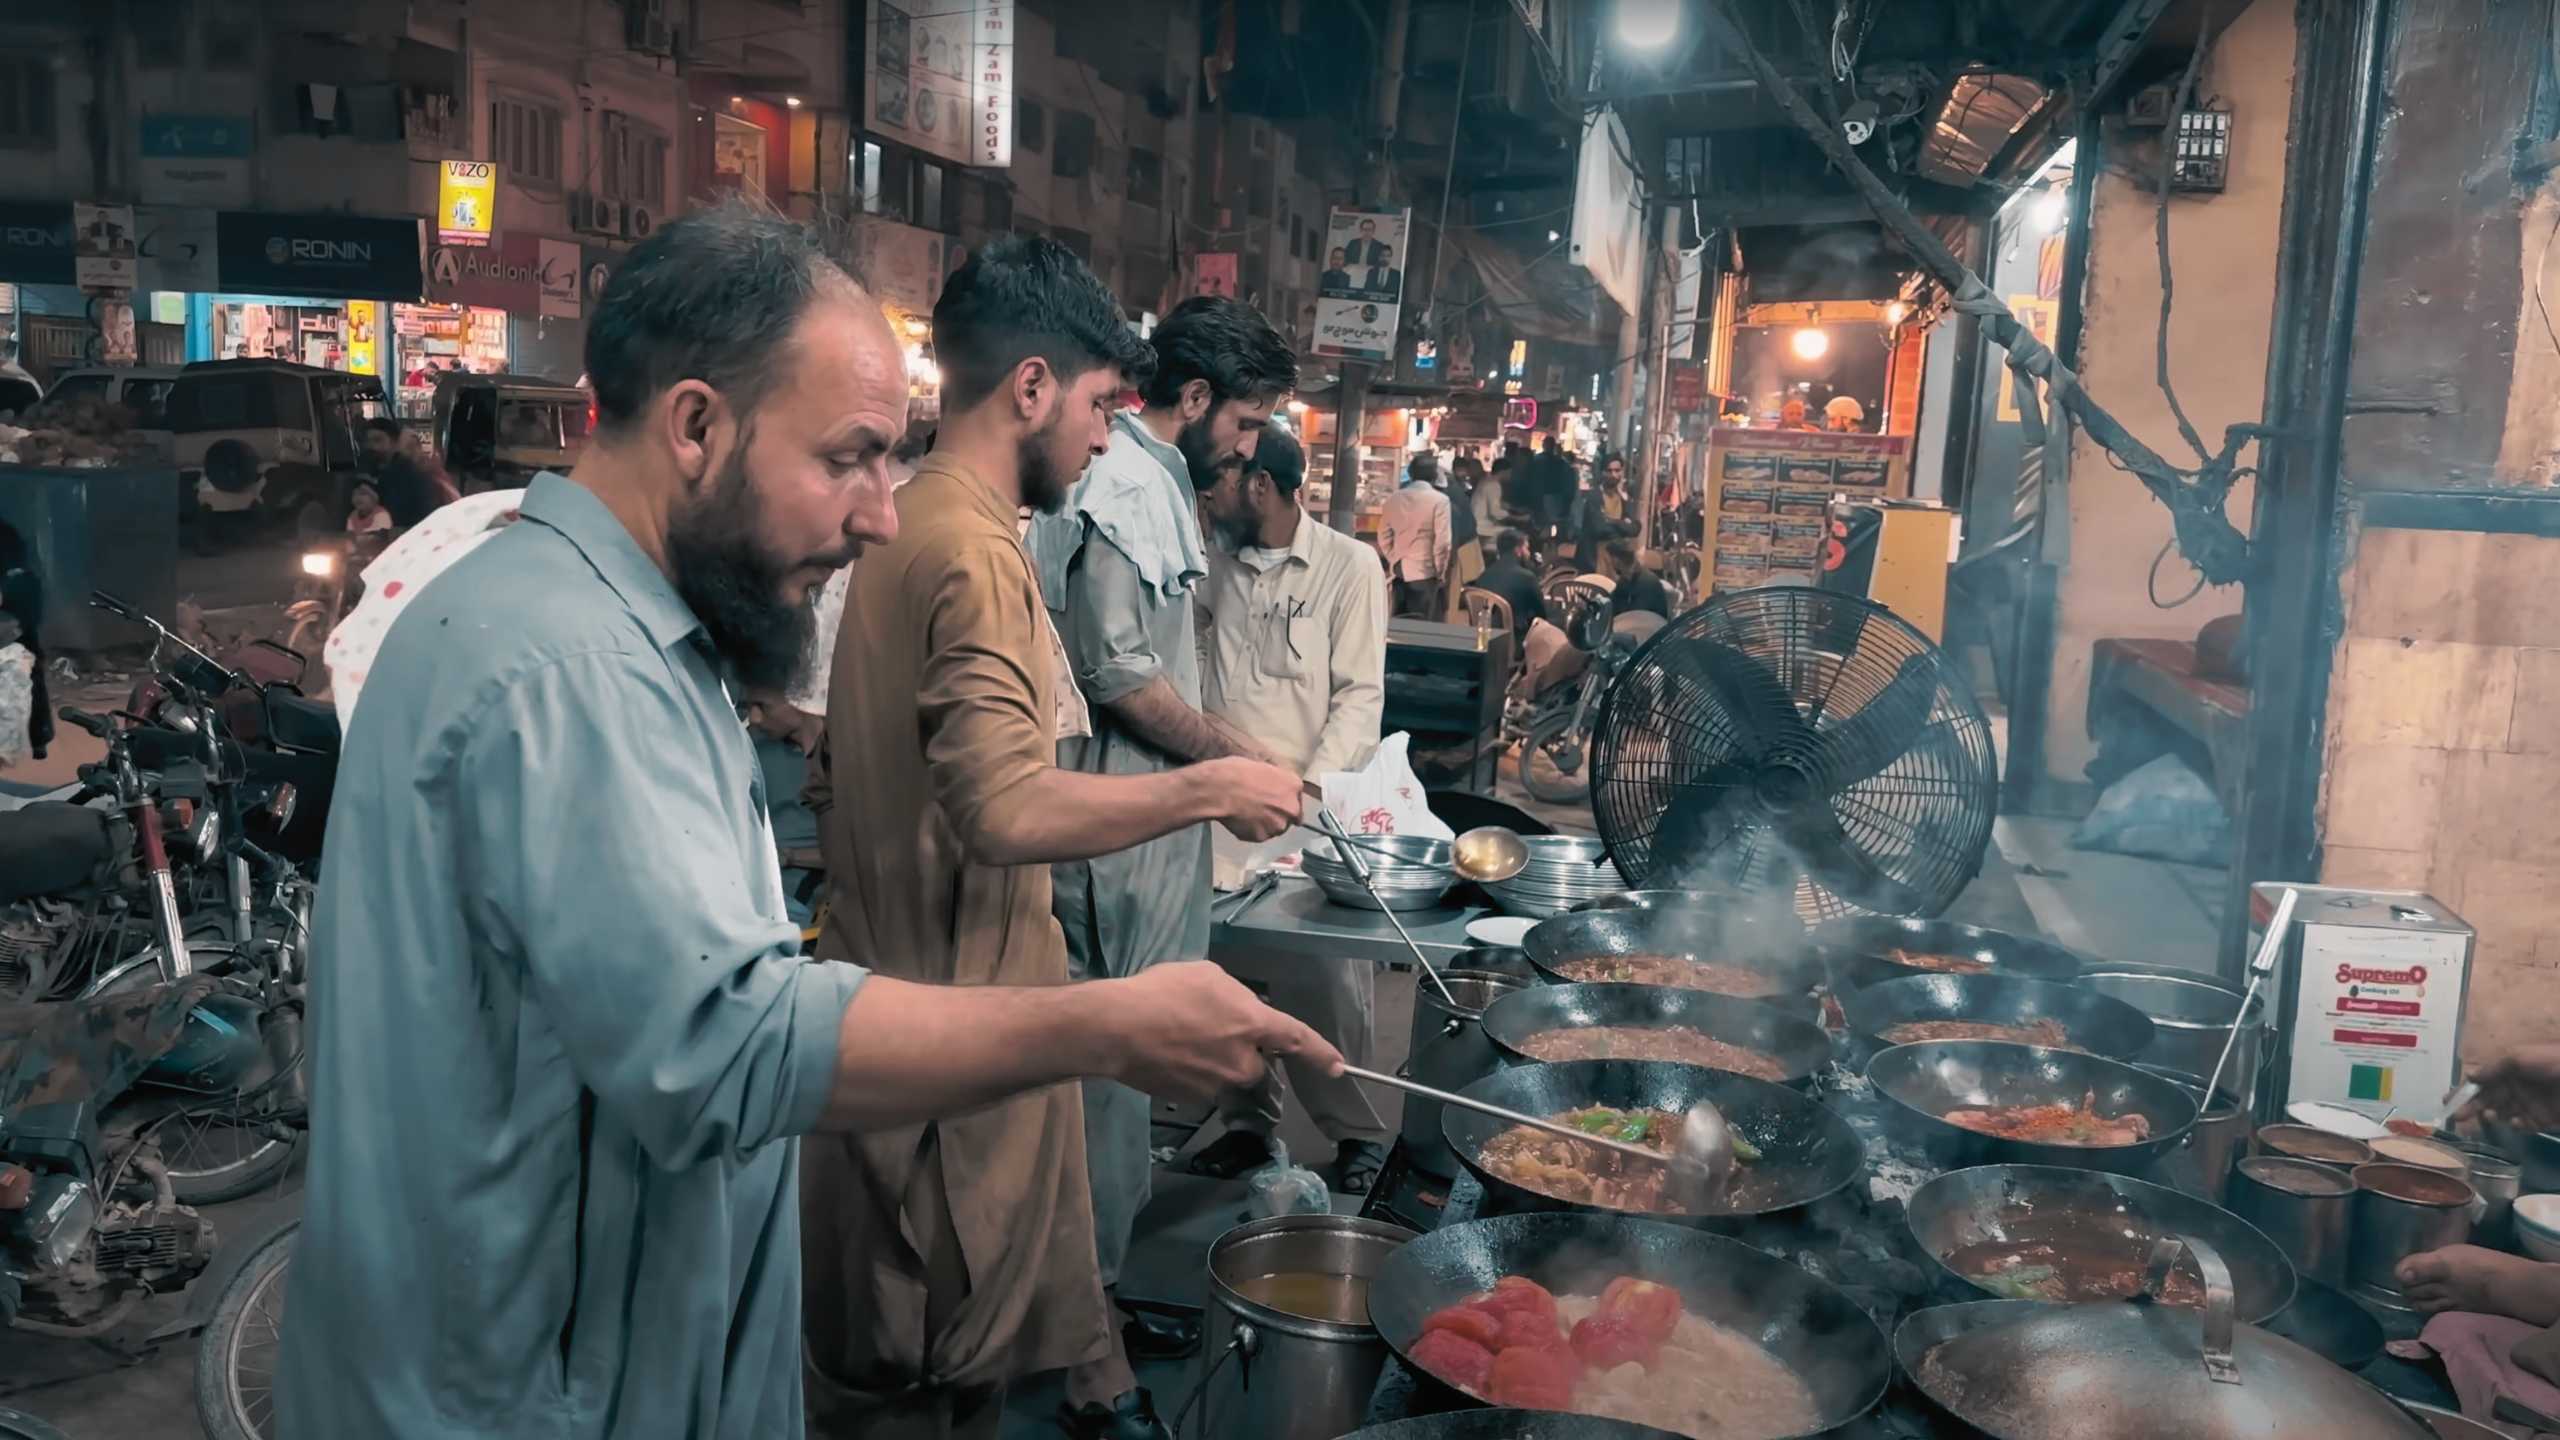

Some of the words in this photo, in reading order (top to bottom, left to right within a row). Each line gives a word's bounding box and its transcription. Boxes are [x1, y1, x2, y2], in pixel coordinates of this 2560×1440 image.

[984, 44, 1003, 83] Zam
[985, 95, 999, 161] Foods
[292, 239, 371, 260] RONIN
